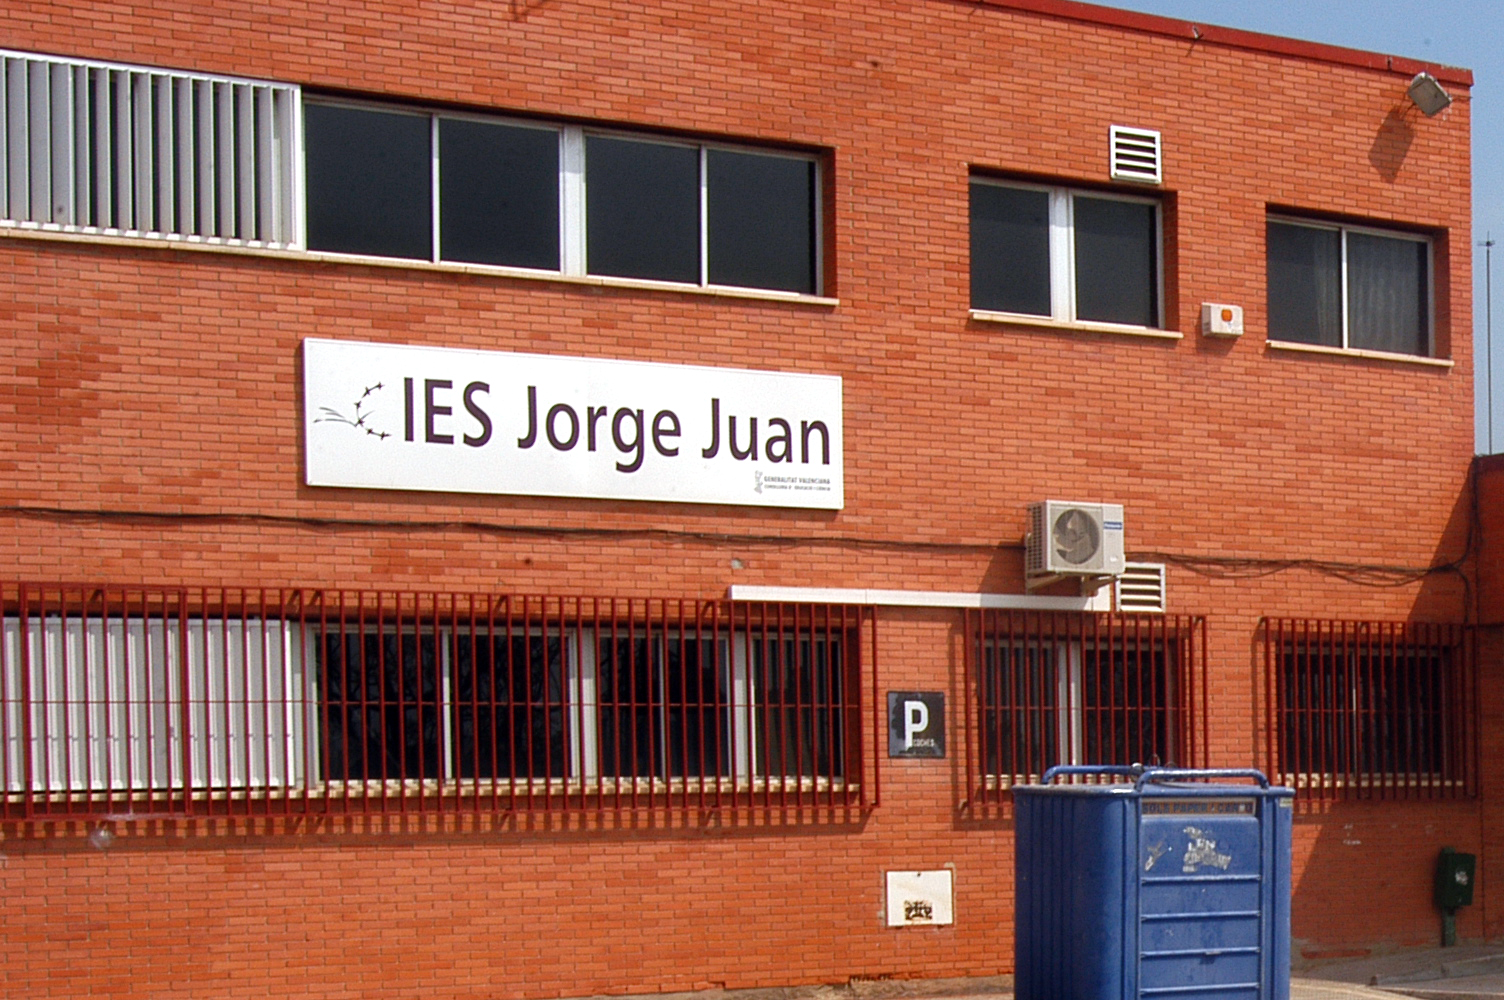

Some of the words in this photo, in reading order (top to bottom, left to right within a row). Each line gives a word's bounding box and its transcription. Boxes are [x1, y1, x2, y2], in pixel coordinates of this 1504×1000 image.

[404, 377, 493, 447] IES
[517, 385, 681, 473] Jorge
[702, 397, 830, 465] Juan
[904, 700, 929, 751] P
